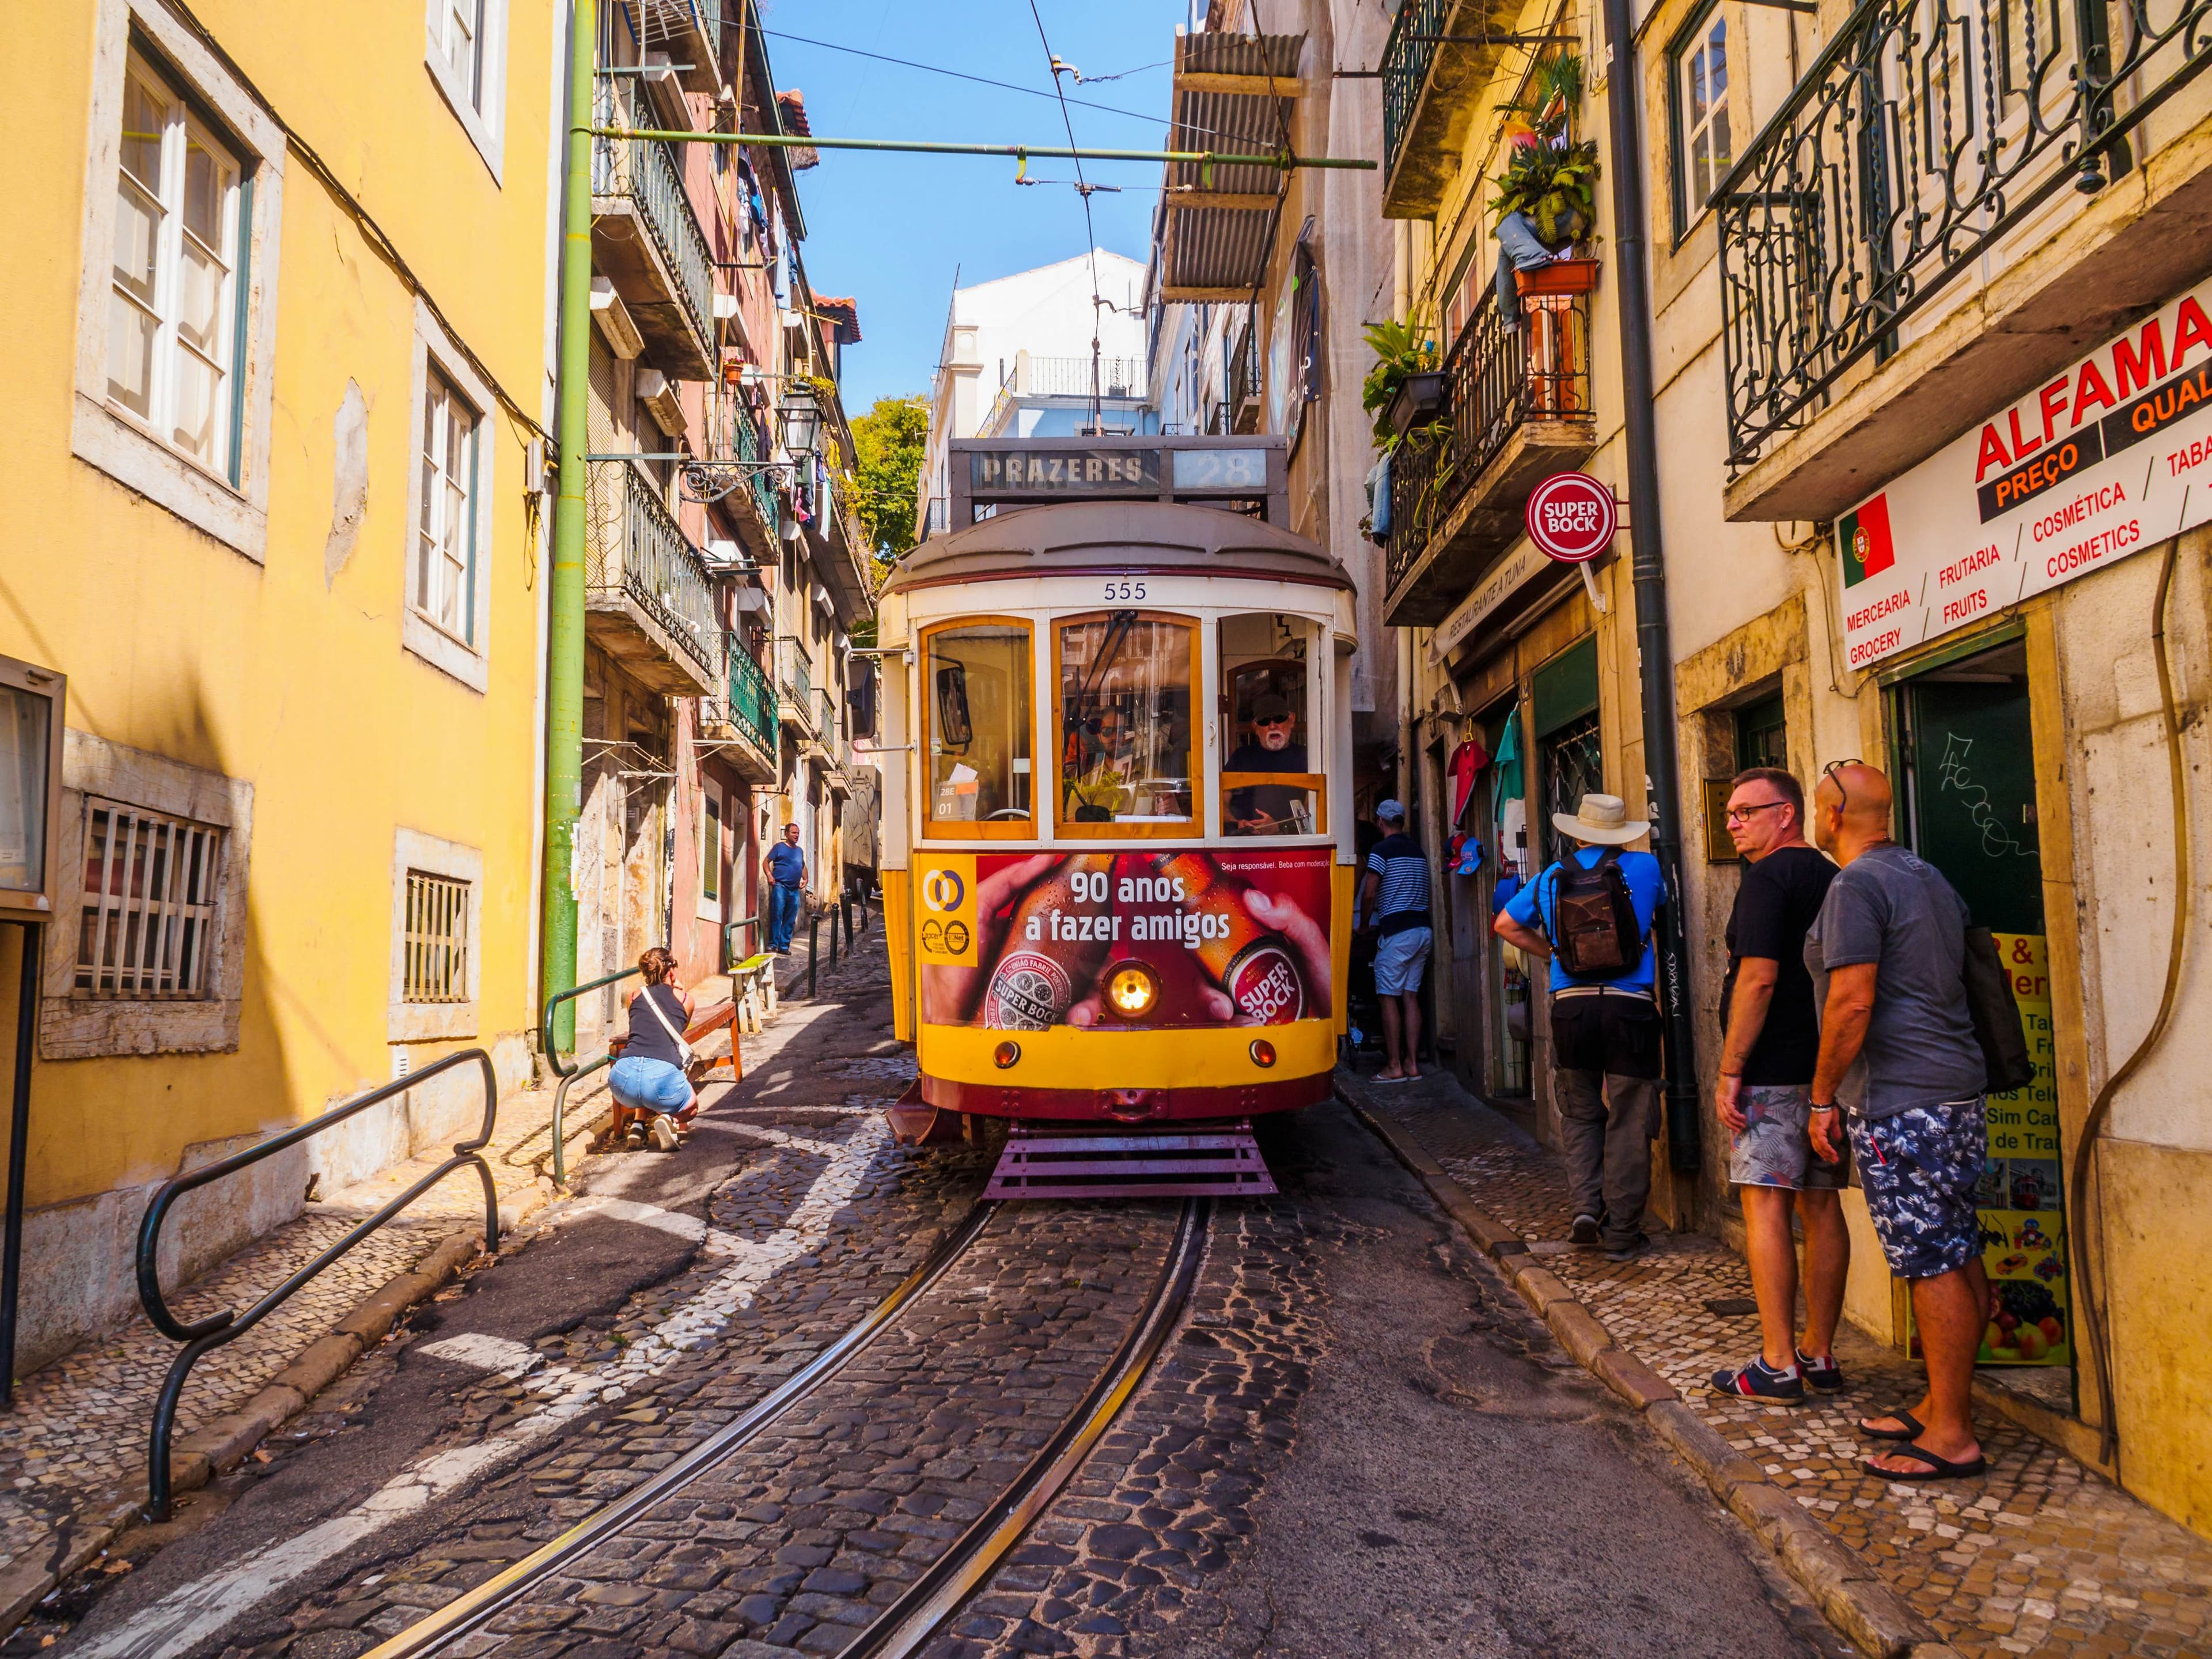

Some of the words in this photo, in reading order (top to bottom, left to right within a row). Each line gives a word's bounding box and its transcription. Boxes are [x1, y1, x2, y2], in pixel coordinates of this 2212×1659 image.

[1975, 295, 2212, 483] ALFAMA
[984, 457, 1142, 482] PRAZERES
[1198, 457, 1252, 487] 28
[1995, 443, 2078, 508] PREÇO
[1544, 501, 1599, 518] SUPER
[1548, 516, 1597, 533] BOCK
[1847, 589, 1910, 632] MERCEARIA
[1939, 544, 2001, 589] FRUTARIA
[2033, 482, 2126, 543] COSMÉTICA
[1104, 582, 1147, 601] 555
[1449, 582, 1497, 641] RESTAURANTE
[1497, 576, 1503, 596] A
[1505, 555, 1526, 589] TUNA
[1850, 628, 1902, 664] GROCERY
[1944, 589, 1987, 624] FRUITS
[2047, 520, 2140, 578] COSMETICS
[941, 788, 955, 796] 28E
[939, 803, 952, 815] 01
[1221, 862, 1236, 872] Seja
[1238, 862, 1277, 871] responsável.
[1071, 872, 1108, 903] 90
[1118, 877, 1185, 903] anos
[1025, 915, 1041, 941] a
[1050, 910, 1121, 941] fazer
[1131, 908, 1231, 949] amigos
[1010, 959, 1029, 969] UNIÃO
[1030, 960, 1051, 974] FABRIL
[995, 980, 1027, 1010] SUPER
[1028, 1003, 1058, 1024] BOCK
[1240, 961, 1288, 1013] SUPER
[1252, 977, 1295, 1024] BOCK
[1987, 1107, 2021, 1124] Sim
[1995, 1132, 2018, 1149] de
